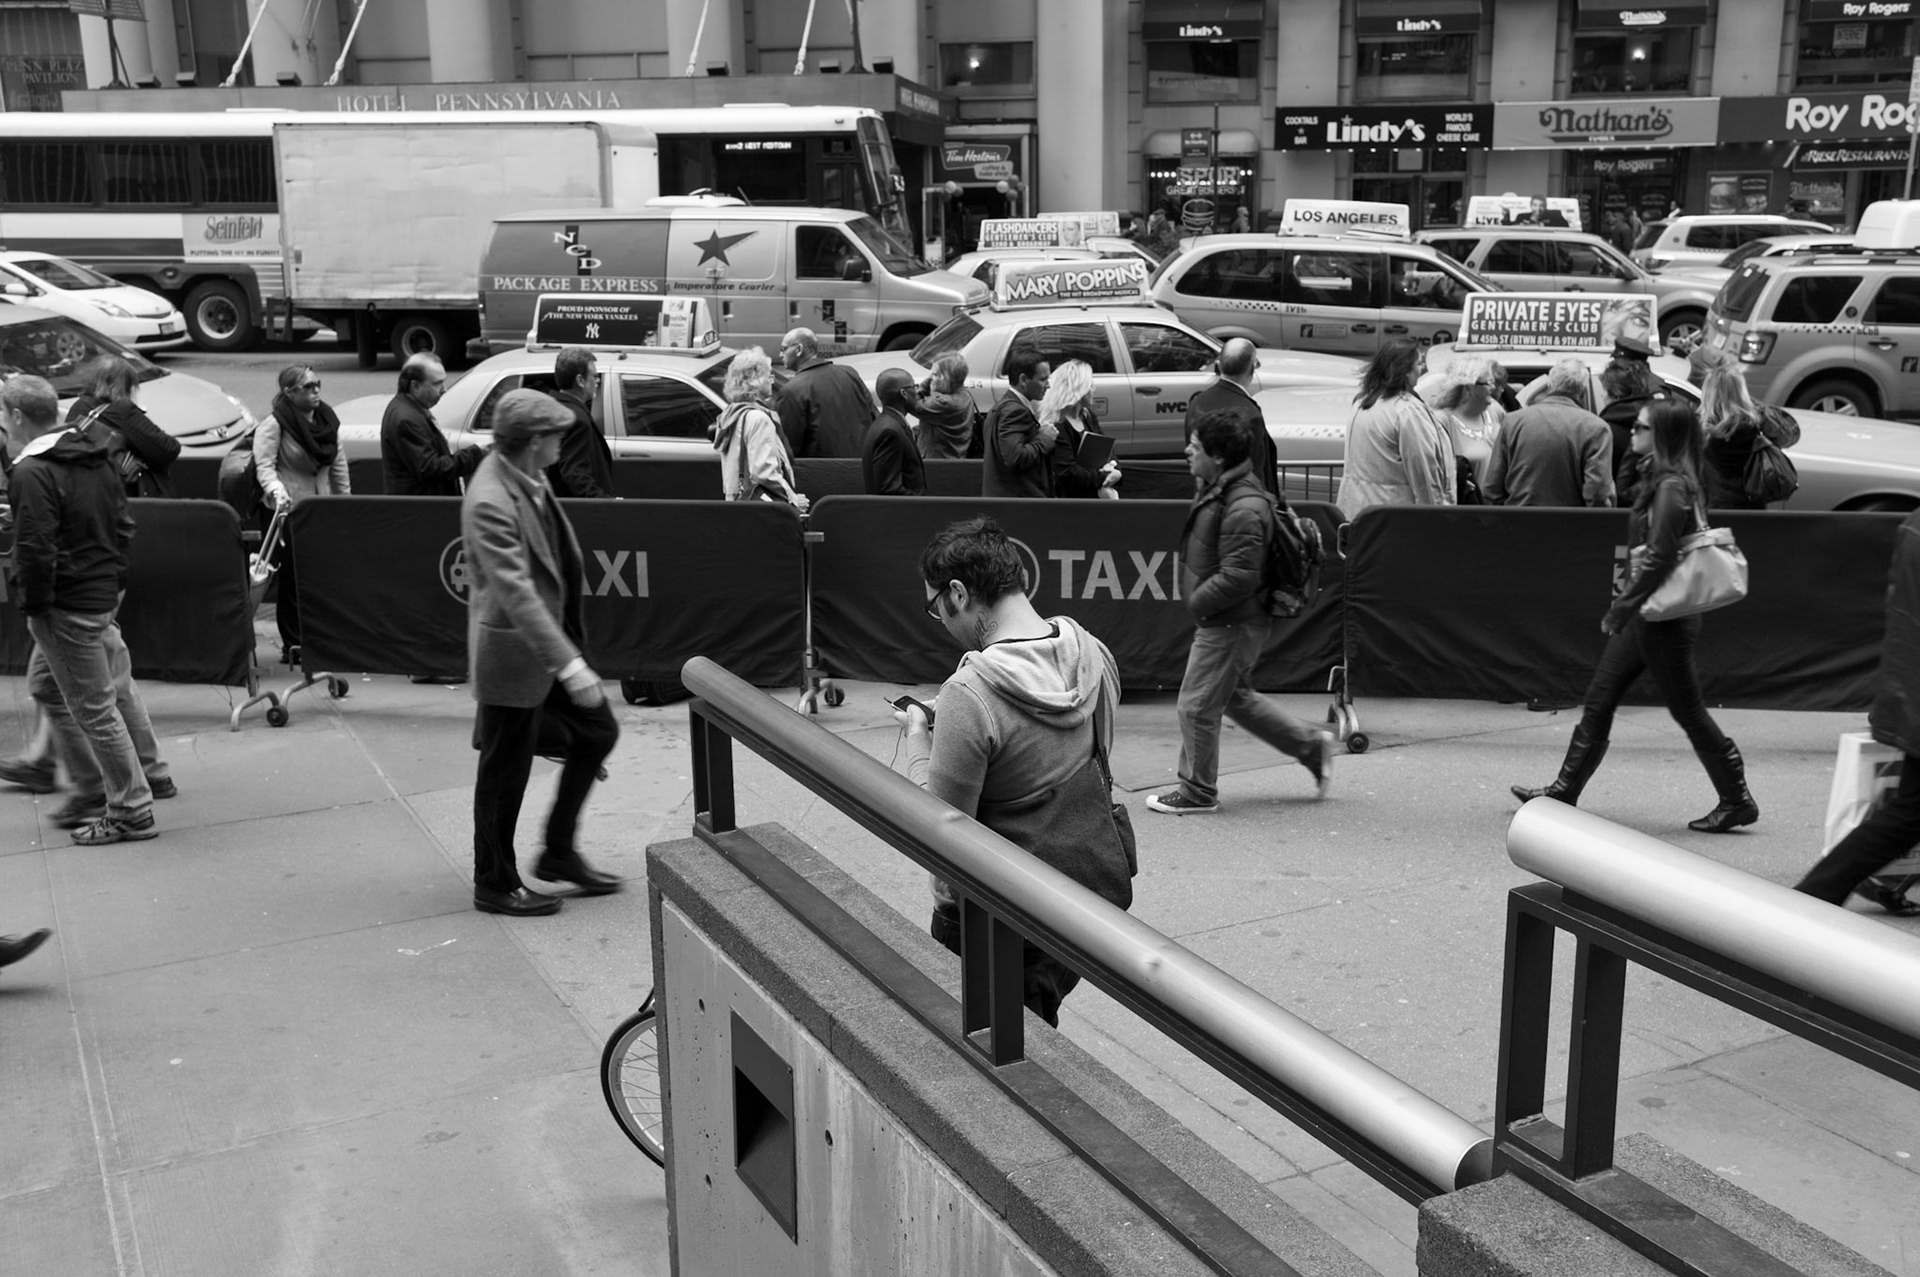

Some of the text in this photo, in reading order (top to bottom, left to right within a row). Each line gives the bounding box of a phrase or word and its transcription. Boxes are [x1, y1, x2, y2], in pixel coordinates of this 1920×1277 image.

[1843, 2, 1909, 16] Roy Rogers
[1179, 24, 1223, 37] Lindy's
[1397, 18, 1442, 31] Lindy's
[6, 60, 83, 72] PENN PLAZ
[22, 73, 79, 83] PAVILION
[337, 91, 621, 112] HOTEL PENNSYLVANIA
[1284, 116, 1318, 125] COCKTAILS
[1445, 113, 1473, 121] WORLD'S
[1539, 105, 1674, 134] Nathan's
[1785, 97, 1849, 133] Roy
[1326, 115, 1426, 142] Lindy's
[1445, 123, 1471, 132] FAMOUS
[1294, 136, 1307, 145] BAR
[1436, 133, 1480, 142] CHEESE CAKE
[946, 149, 963, 162] Tim
[1594, 159, 1655, 173] Roy Rogers
[1294, 210, 1398, 226] LOS ANGELES
[205, 216, 263, 240] Seinfeld
[986, 222, 1057, 234] FLASHDANCERS
[494, 277, 658, 292] PACKAGE EXPRESS
[738, 283, 776, 291] Courier
[1006, 262, 1144, 300] MARY POPPINS
[1472, 299, 1601, 322] PRIVATE EYES
[1471, 320, 1598, 333] GENTLEMEN'S CLUB
[1471, 334, 1597, 347] W 45th ST (BTWN 8TH & 9TH AVE)
[1156, 403, 1187, 414] NYC
[581, 549, 649, 598] XI
[1048, 549, 1182, 600] TAXI
